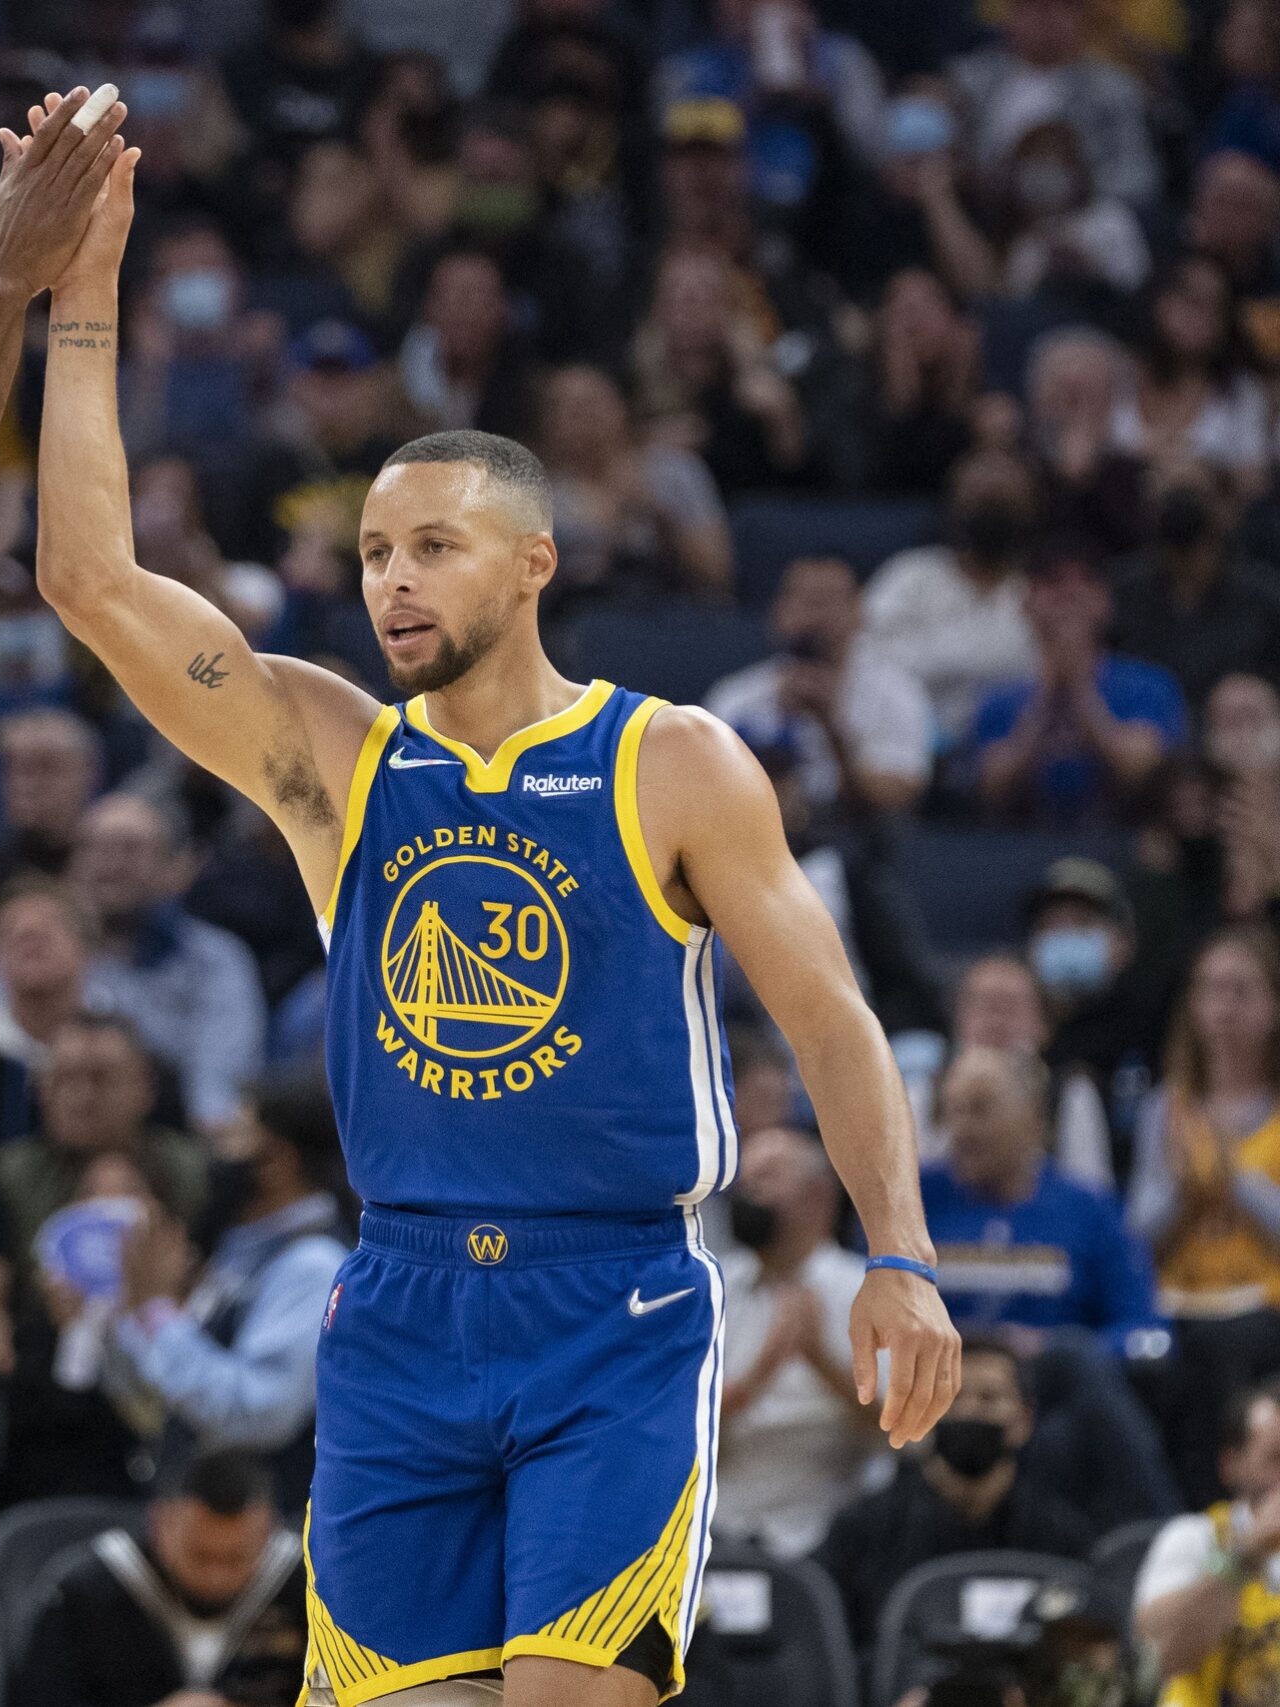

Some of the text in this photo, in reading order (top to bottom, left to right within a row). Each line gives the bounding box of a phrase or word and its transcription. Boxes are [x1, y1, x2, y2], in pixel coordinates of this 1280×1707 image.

[523, 774, 602, 793] Rakuten
[383, 825, 580, 898] GOLDEN STATE
[479, 901, 549, 961] 30
[376, 1010, 583, 1101] WARRIORS
[470, 1235, 506, 1260] W
